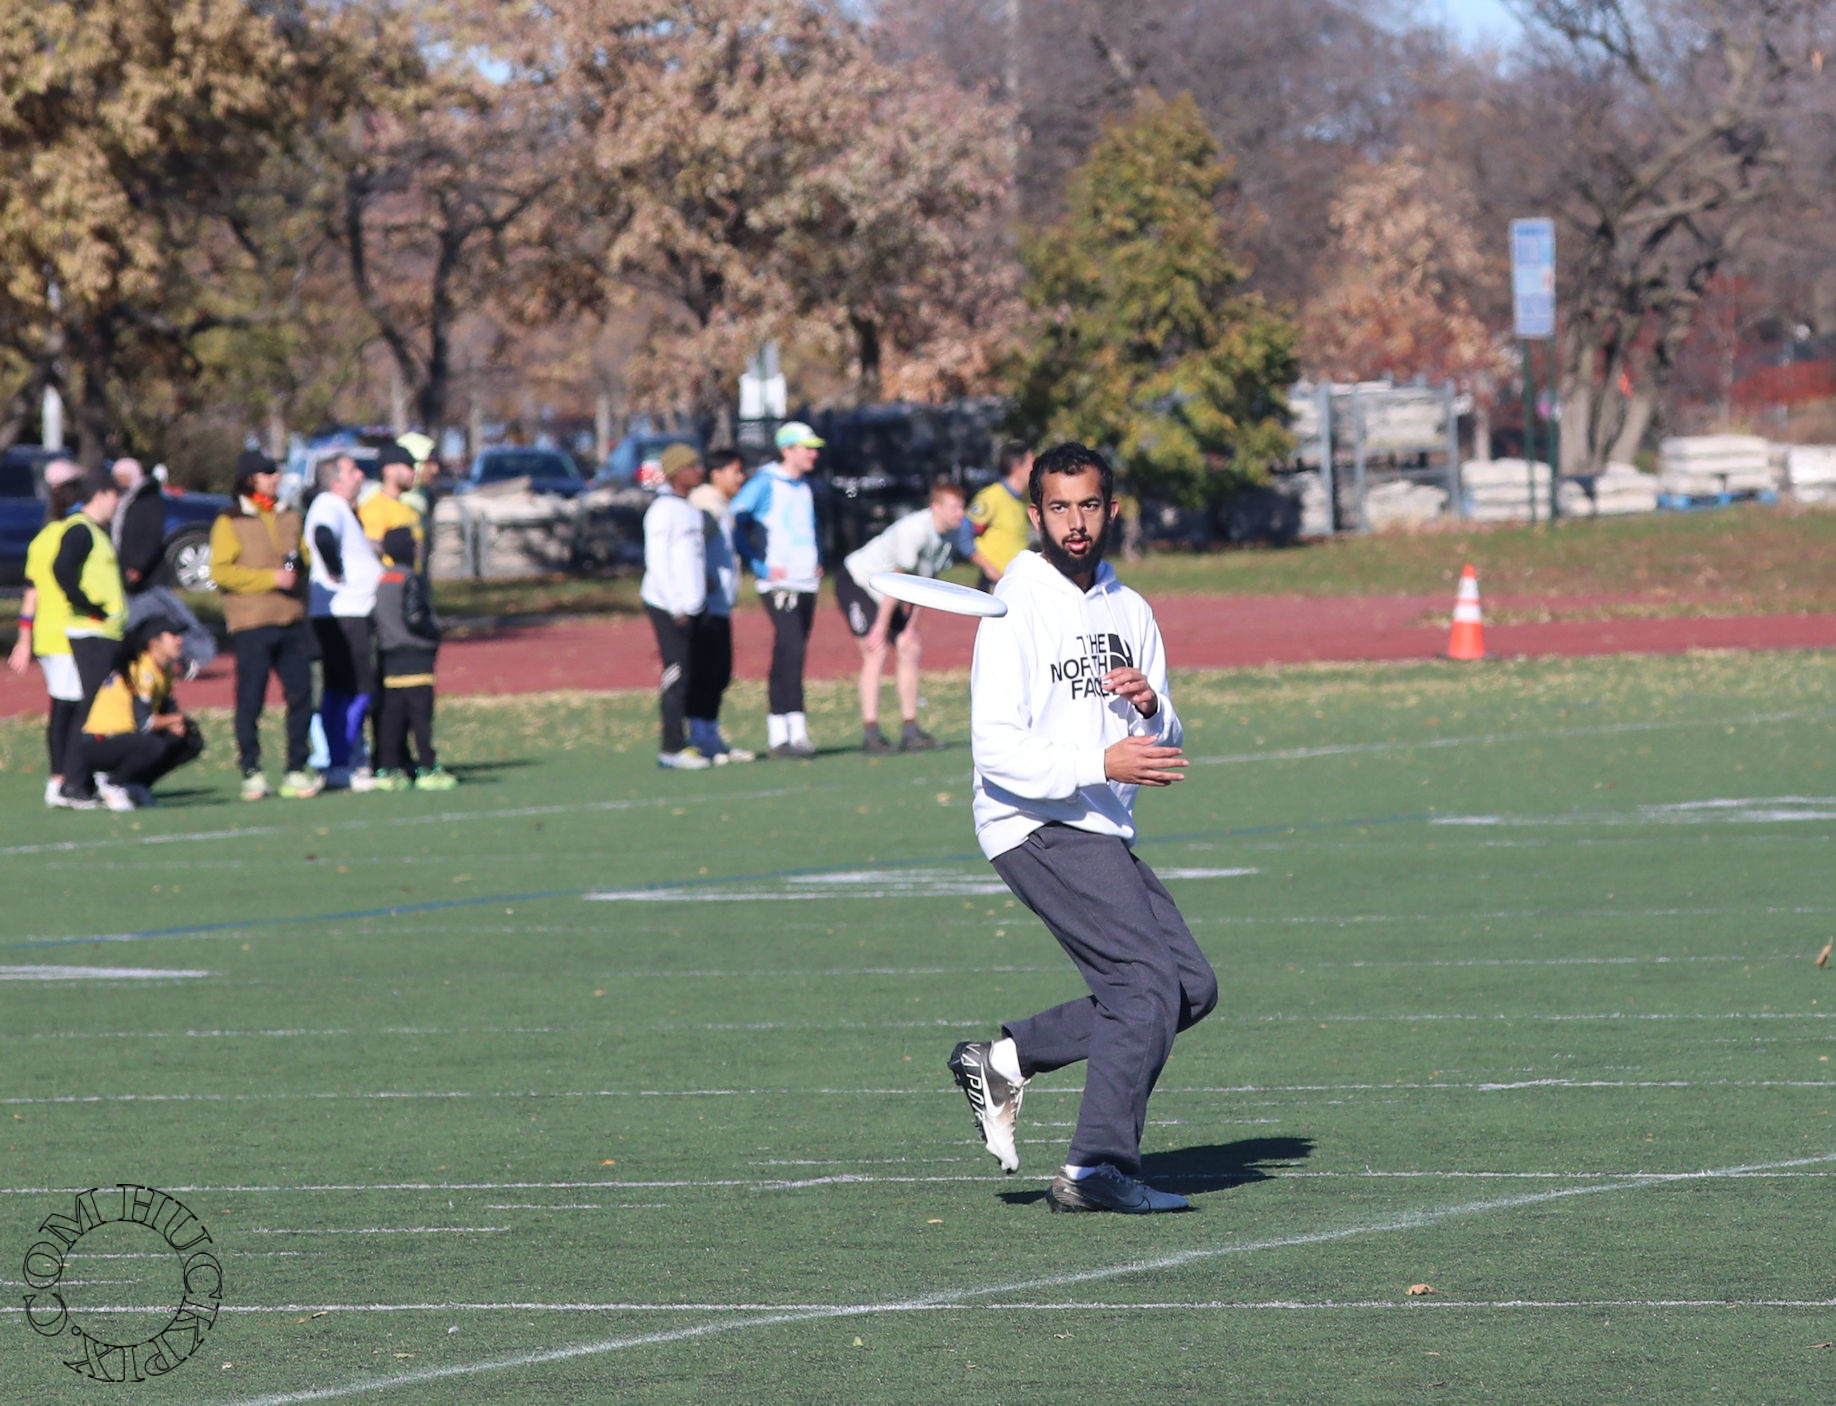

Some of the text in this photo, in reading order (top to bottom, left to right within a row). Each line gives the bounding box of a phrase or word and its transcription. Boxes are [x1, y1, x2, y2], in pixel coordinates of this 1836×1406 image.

[1076, 633, 1107, 655] THE
[1050, 655, 1108, 683] NORTH
[1071, 677, 1119, 700] FAC
